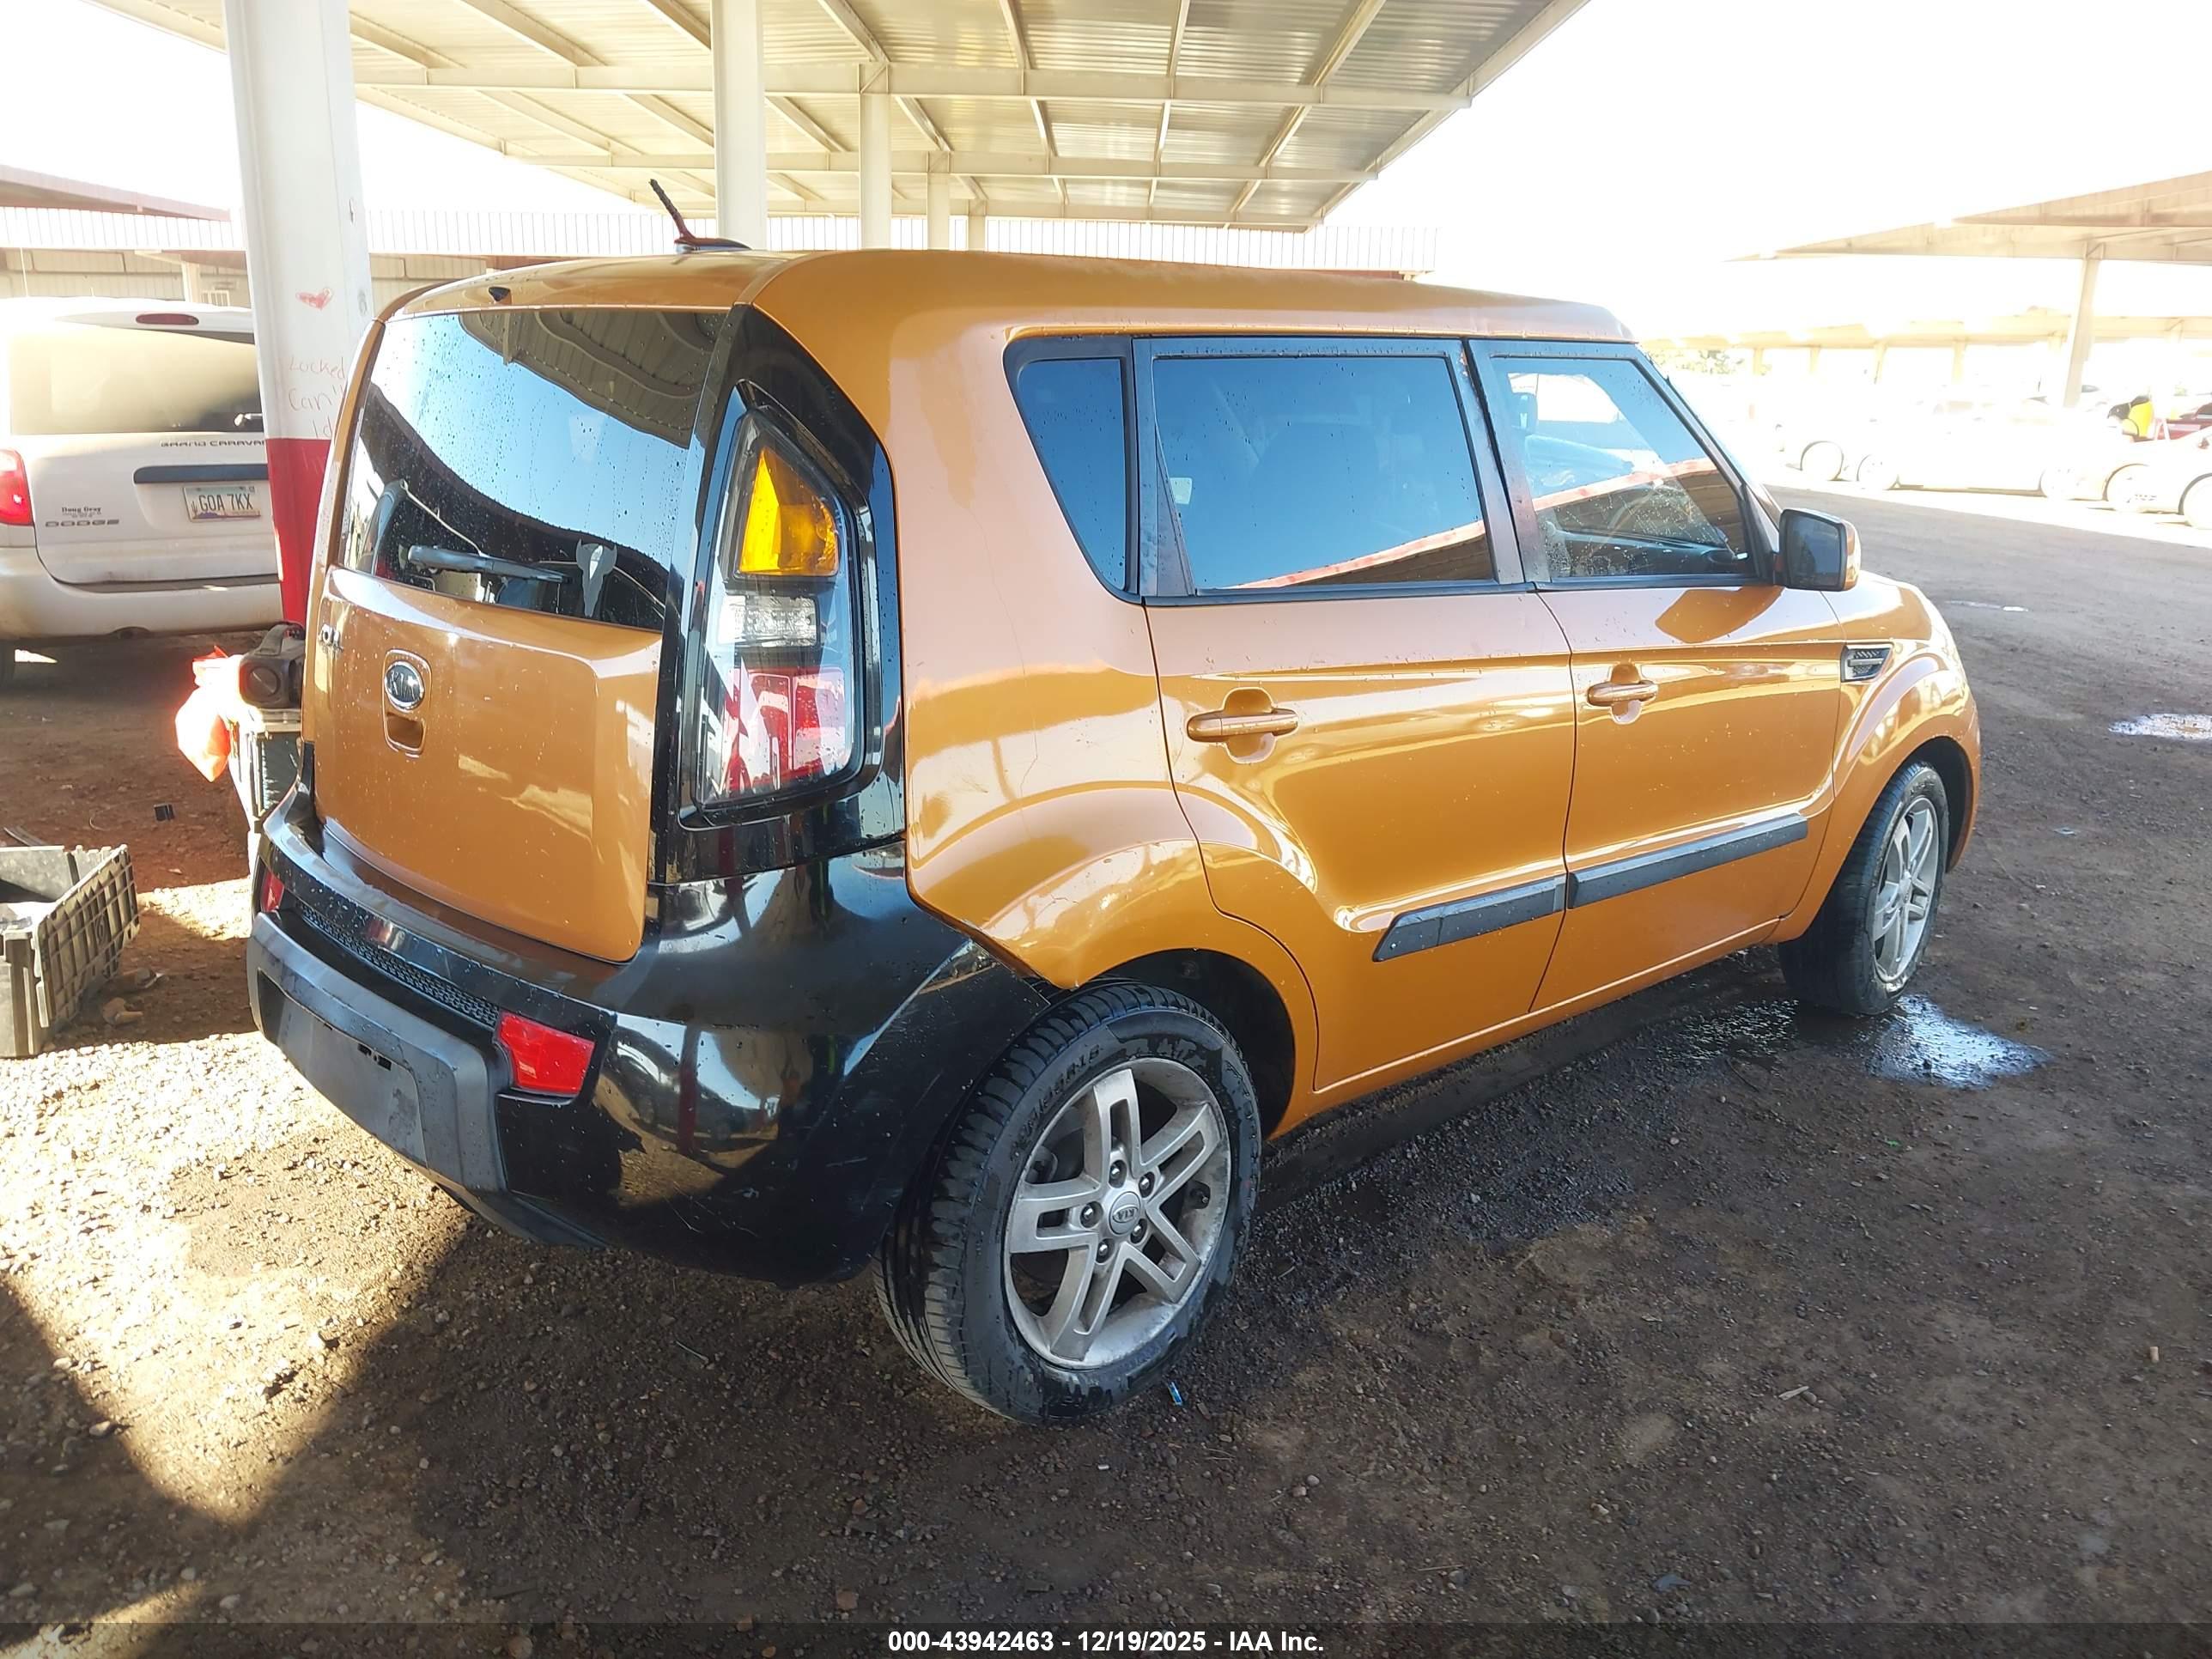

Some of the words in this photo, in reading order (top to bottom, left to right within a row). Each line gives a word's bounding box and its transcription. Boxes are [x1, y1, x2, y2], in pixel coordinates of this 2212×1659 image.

[289, 356, 345, 379] Locked
[227, 492, 253, 511] 7KX
[45, 519, 119, 528] DODGE
